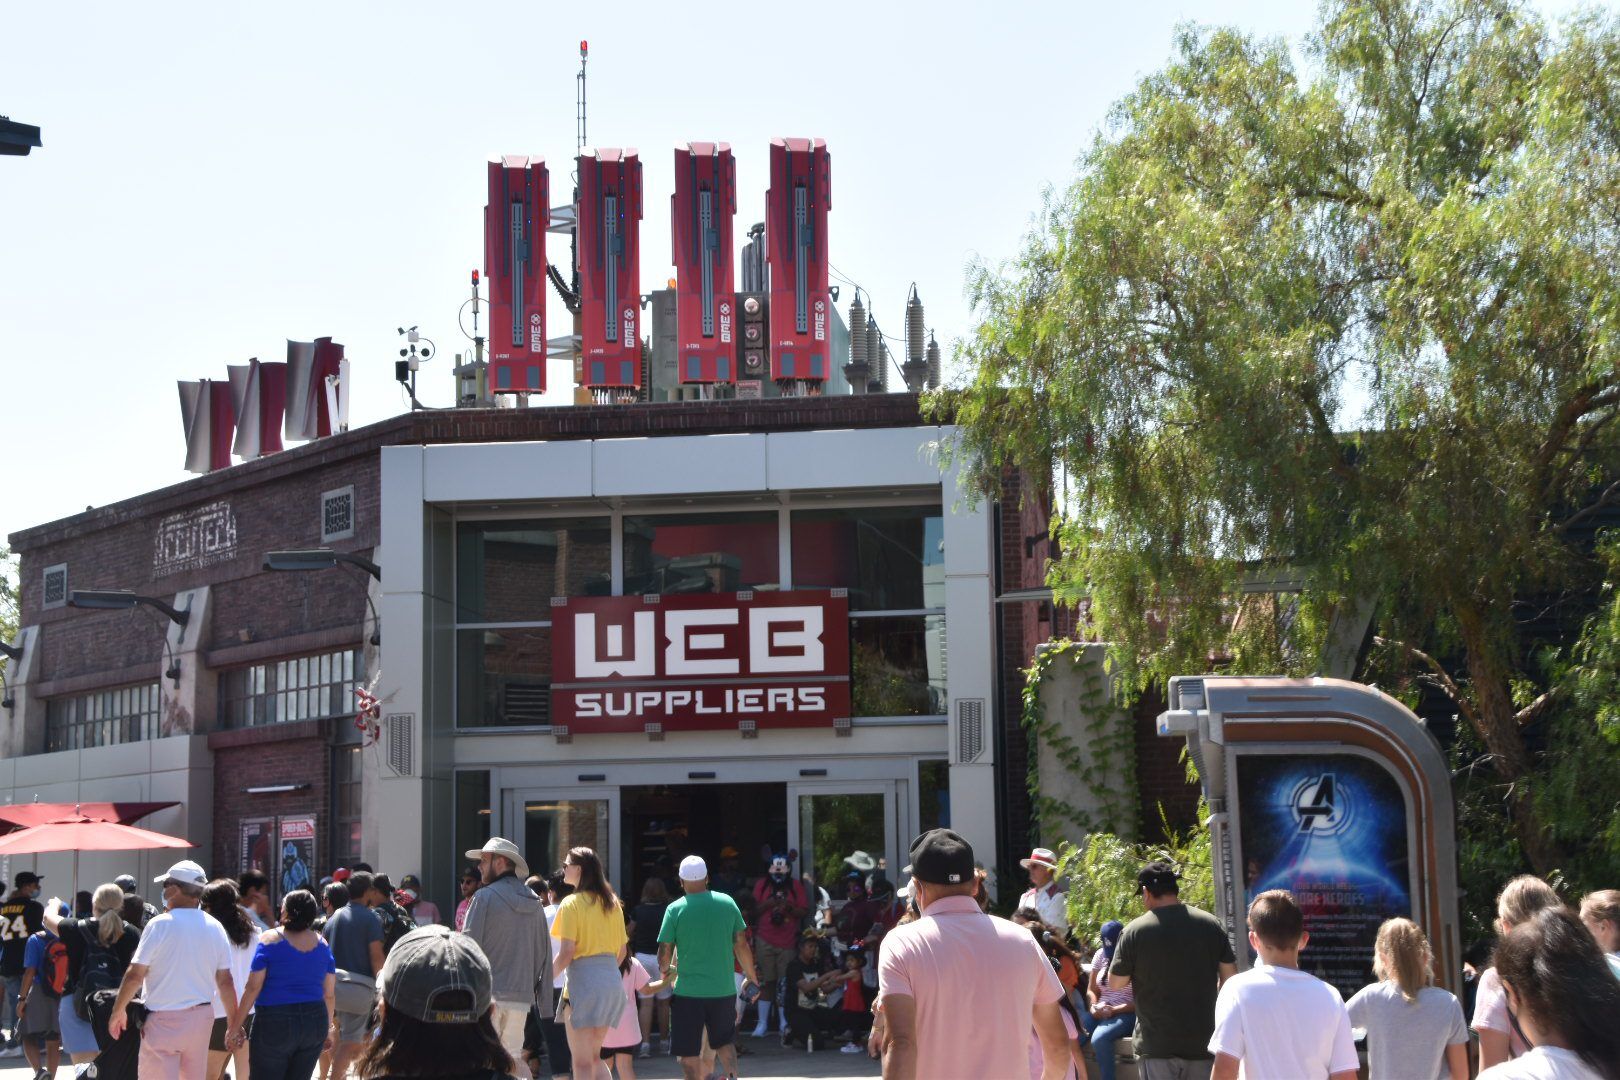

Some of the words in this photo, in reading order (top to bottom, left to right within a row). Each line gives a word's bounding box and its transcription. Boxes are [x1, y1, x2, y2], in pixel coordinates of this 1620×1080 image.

[574, 605, 825, 678] WEB
[575, 687, 826, 718] SUPPLIERS
[0, 914, 28, 940] 24
